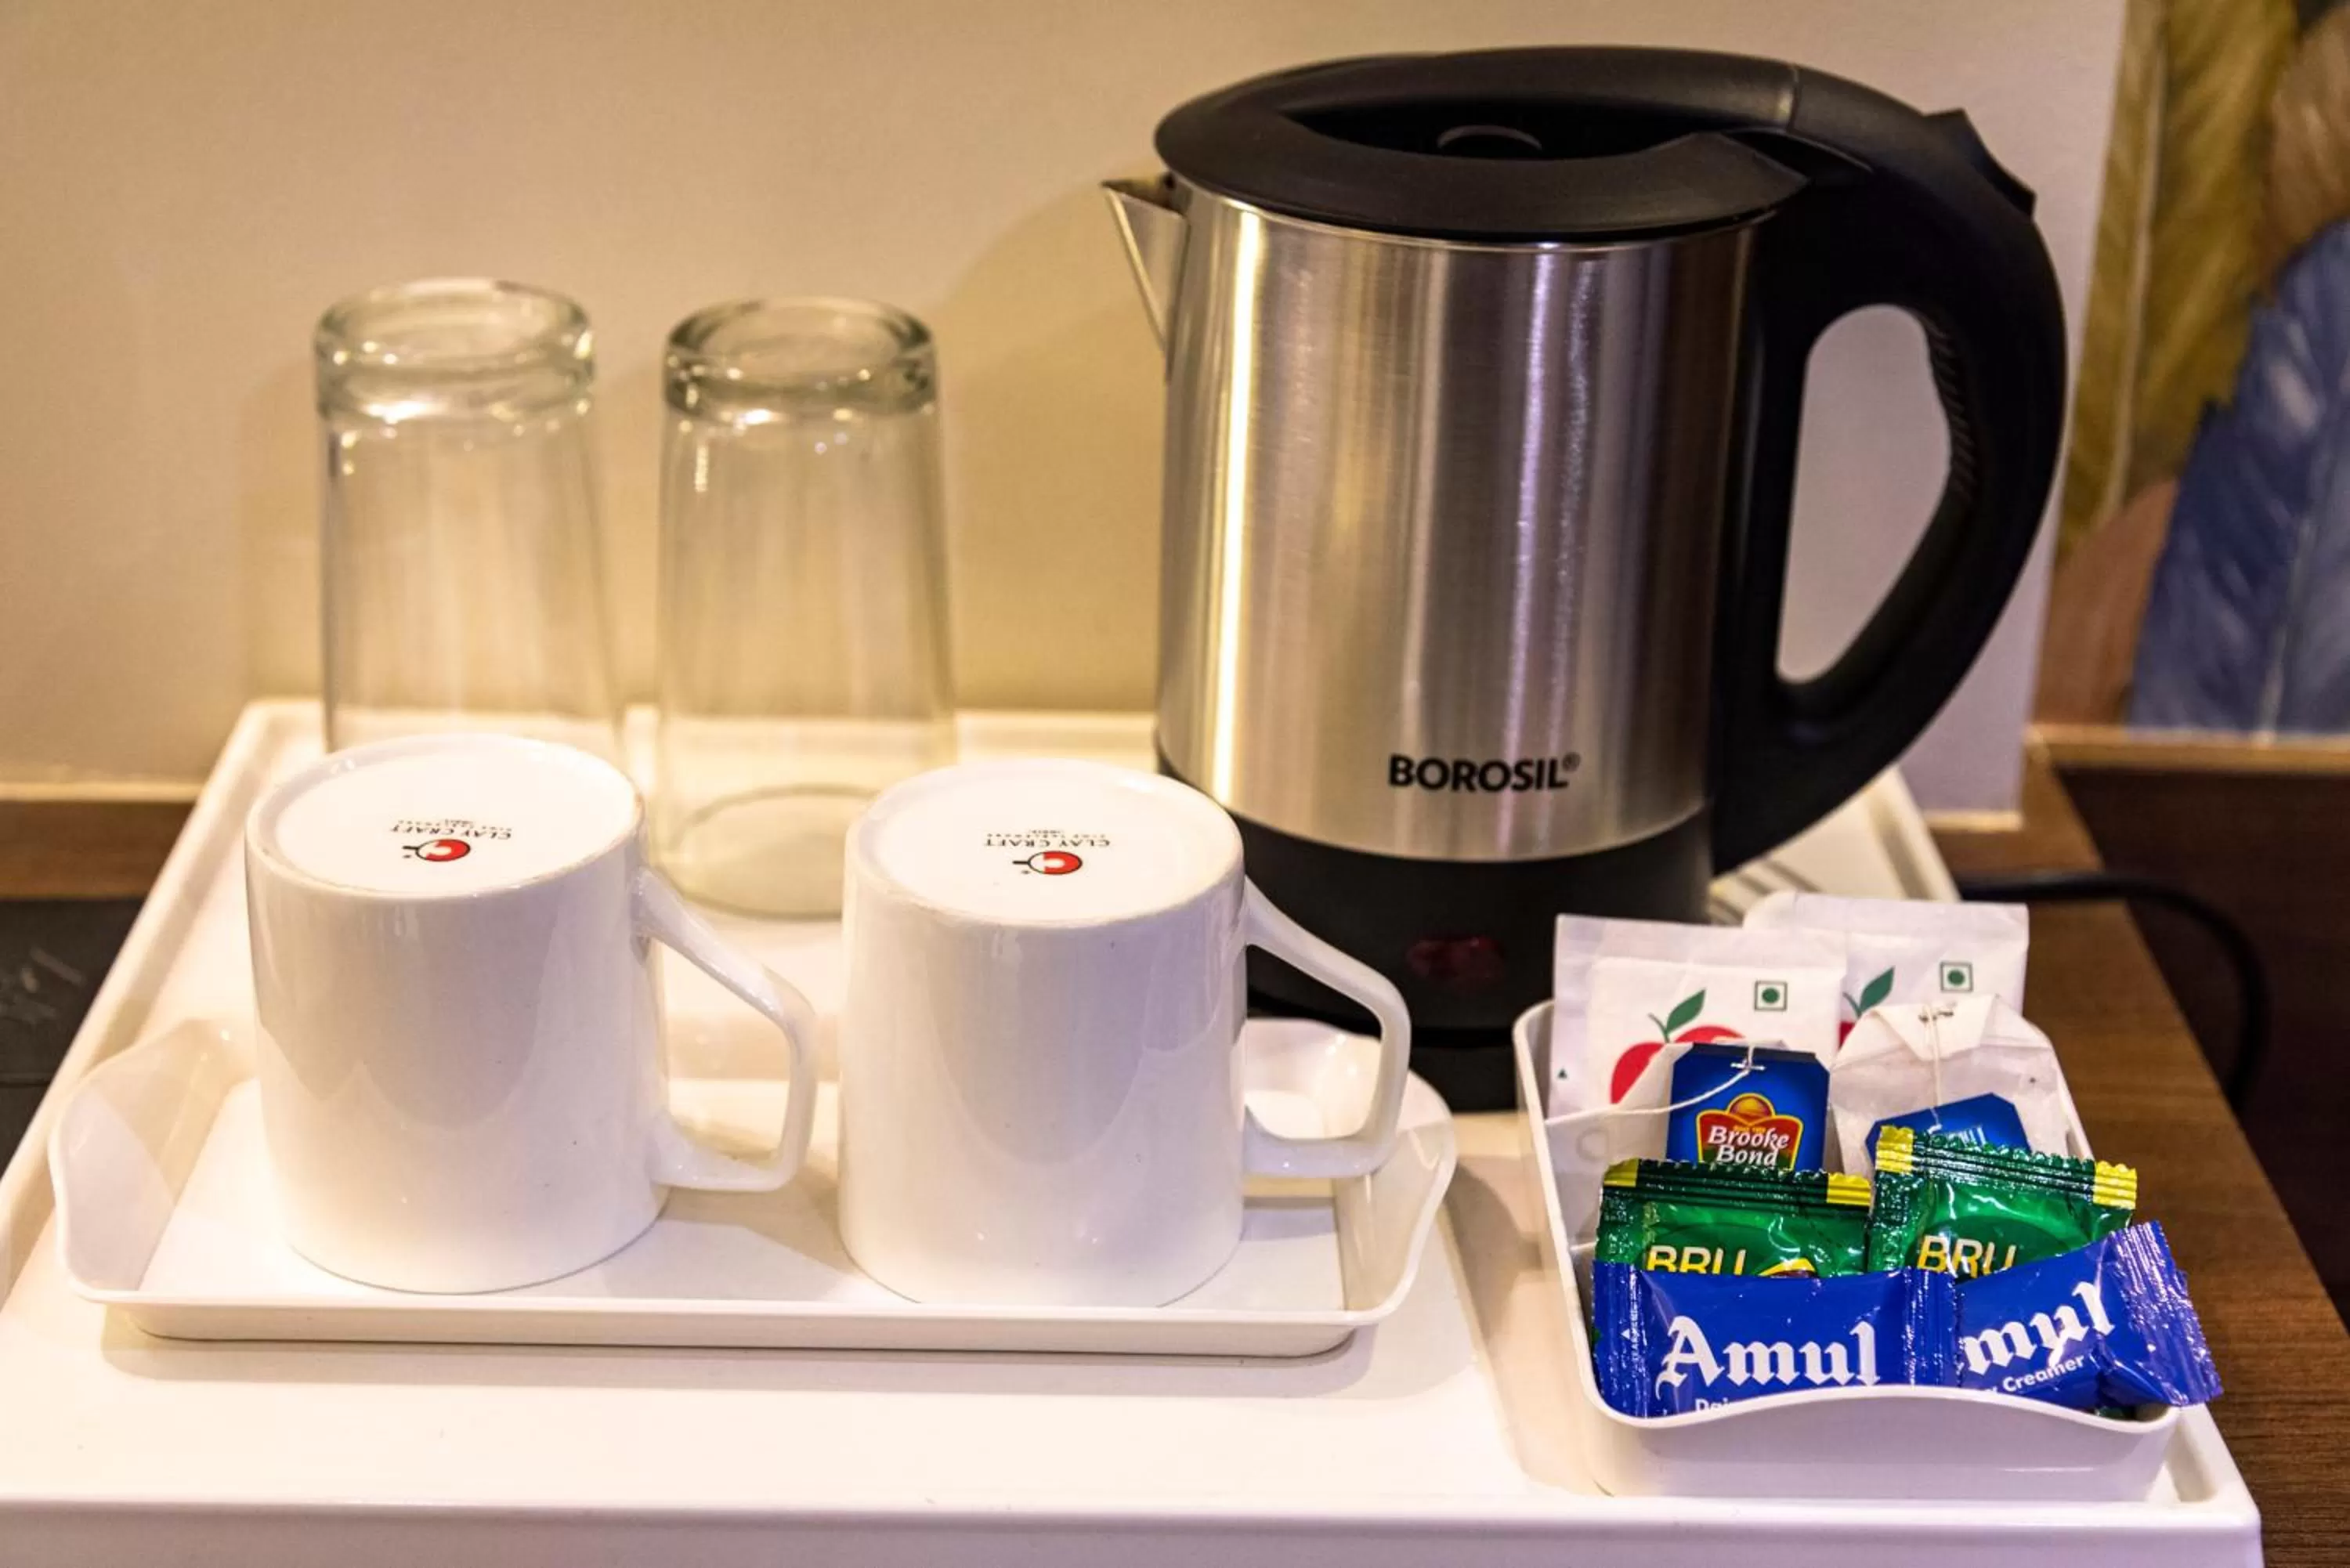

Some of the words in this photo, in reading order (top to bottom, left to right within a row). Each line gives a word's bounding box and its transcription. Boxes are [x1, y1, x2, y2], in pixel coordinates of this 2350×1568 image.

[985, 838, 1050, 847] CRAFT
[1058, 839, 1111, 847] CLAY
[1708, 1125, 1791, 1151] Brooke
[1716, 1143, 1780, 1167] Bond
[1917, 1235, 2017, 1278] BRU
[1960, 1281, 2116, 1375] mul
[1654, 1315, 1881, 1400] Amul
[2002, 1355, 2085, 1393] Creamer
